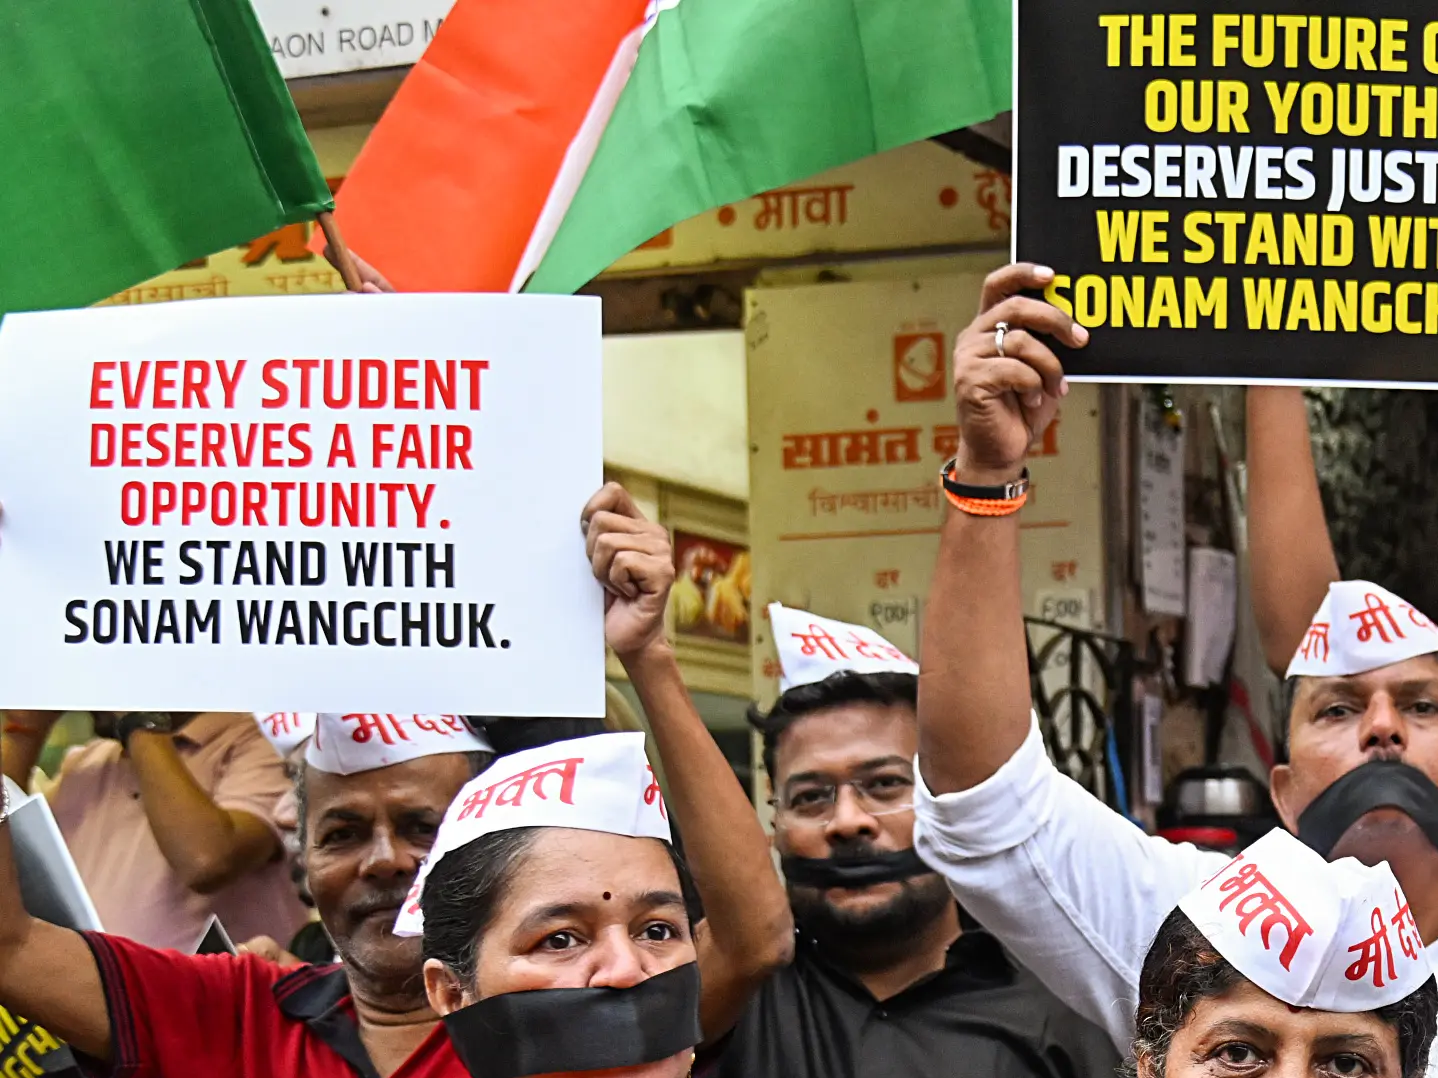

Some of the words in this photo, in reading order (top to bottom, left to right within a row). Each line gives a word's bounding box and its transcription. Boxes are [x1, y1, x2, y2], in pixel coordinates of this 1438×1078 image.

[339, 22, 413, 52] ROAD
[1099, 14, 1197, 68] THE
[1212, 16, 1408, 74] FUTURE
[1144, 79, 1250, 134] OUR
[1265, 81, 1438, 139] YOUTH
[1057, 144, 1317, 200] DESERVES
[752, 185, 855, 231] मावा
[1095, 210, 1169, 264] WE
[1182, 211, 1355, 268] STAND
[1044, 275, 1228, 330] SONAM
[89, 359, 246, 410] EVERY
[261, 358, 490, 411] STUDENT
[89, 422, 312, 468] DESERVES
[326, 423, 357, 468] A
[371, 424, 473, 469] FAIR
[782, 409, 923, 471] सामंत
[119, 481, 450, 529] OPPORTUNITY.
[104, 540, 165, 586] WE
[178, 541, 327, 587] STAND
[341, 542, 456, 588] WITH
[63, 600, 222, 645] SONAM
[235, 600, 511, 649] WANGCHUK.
[791, 624, 851, 661] मी
[1349, 593, 1408, 643] मी
[456, 757, 584, 821] भक्त
[1219, 863, 1314, 972] भक्त
[1345, 907, 1398, 988] मी
